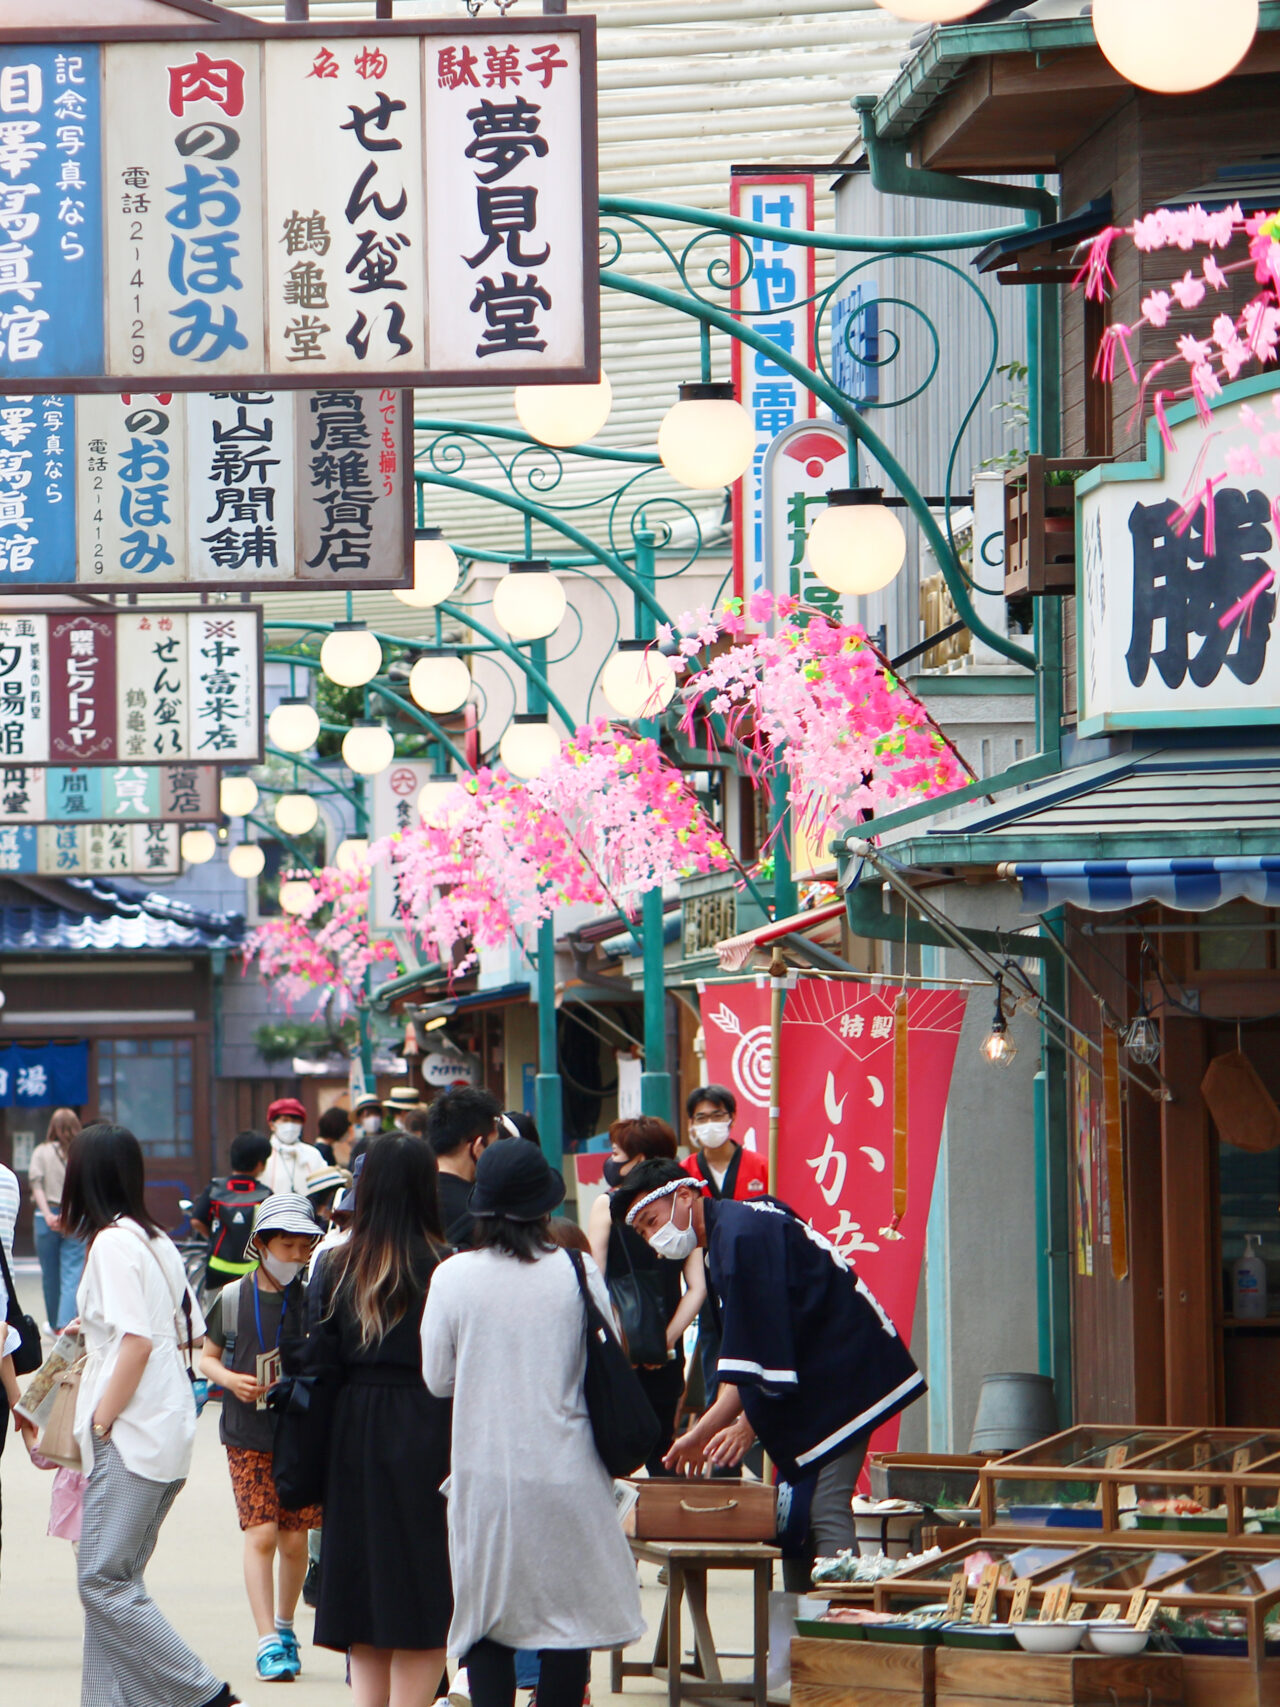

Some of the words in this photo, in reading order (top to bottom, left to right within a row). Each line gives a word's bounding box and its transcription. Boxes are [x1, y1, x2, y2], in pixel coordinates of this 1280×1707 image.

[303, 47, 388, 79] 名物
[437, 44, 568, 90] 駄菓子
[54, 53, 87, 260] 記念写真なら
[460, 95, 550, 358] 夢見堂
[196, 641, 247, 751] 中富米店
[839, 1013, 893, 1039] 特製
